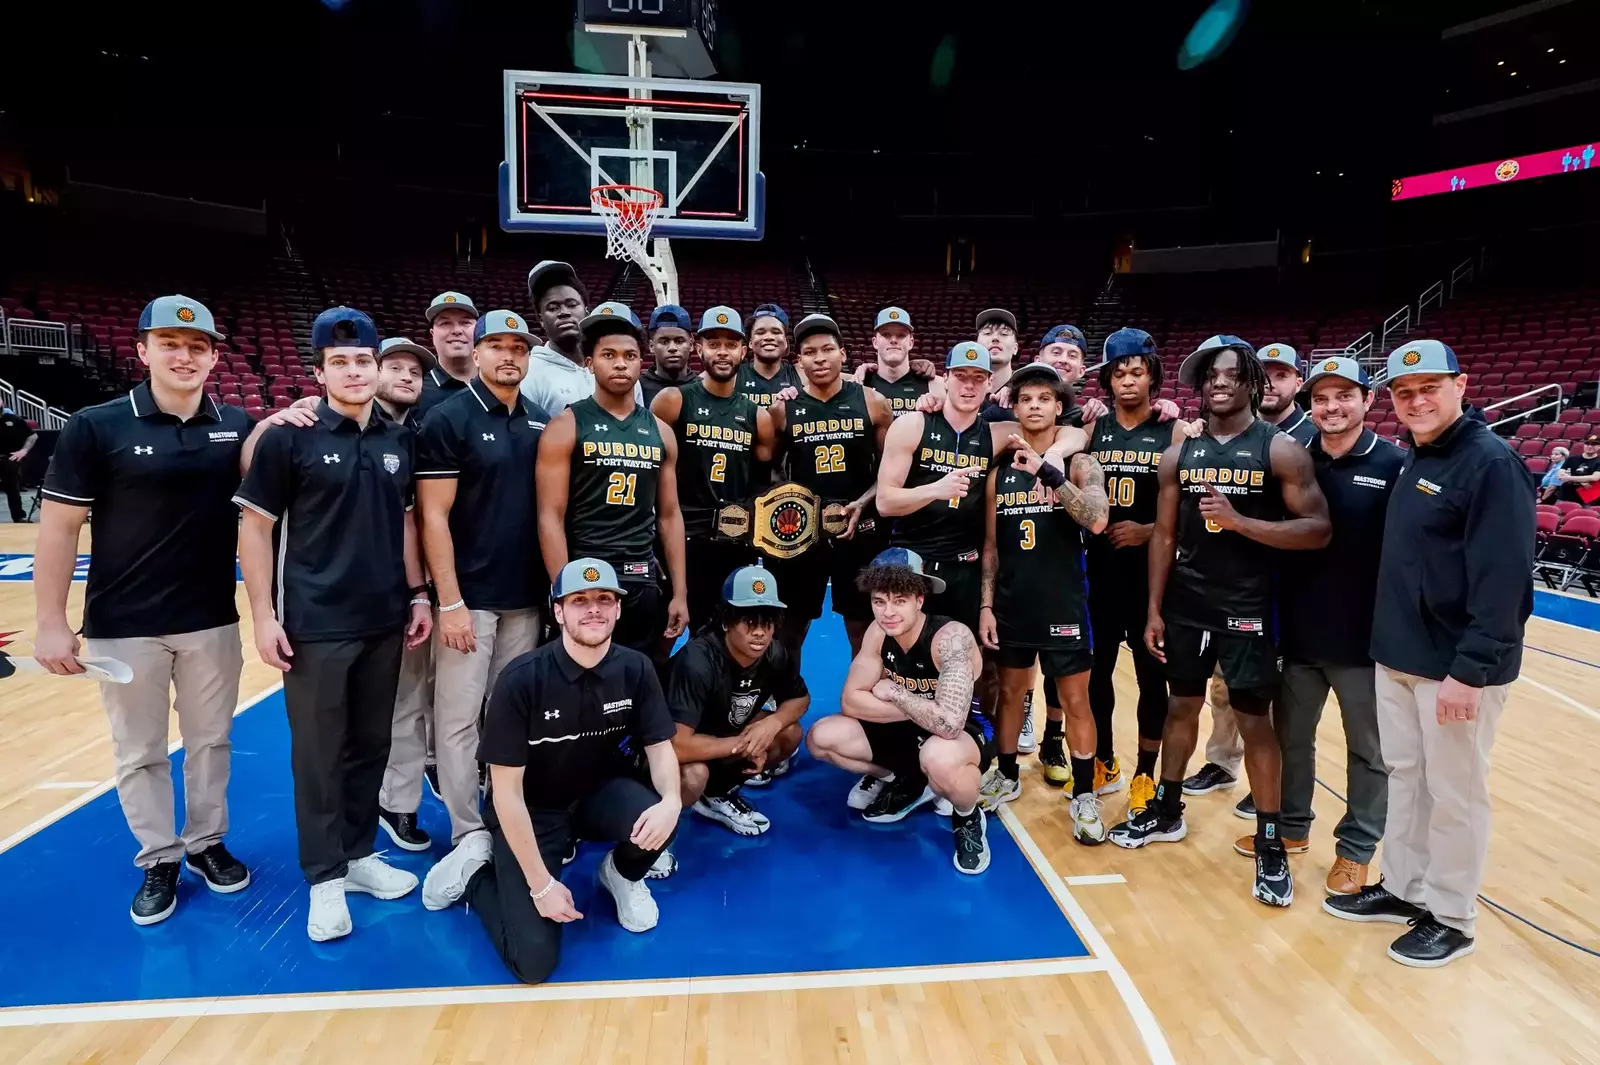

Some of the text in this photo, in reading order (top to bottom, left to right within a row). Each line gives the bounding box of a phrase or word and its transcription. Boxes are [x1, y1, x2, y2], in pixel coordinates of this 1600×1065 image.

[686, 423, 752, 445] PURDUE
[792, 418, 865, 437] PURDUE
[696, 438, 743, 452] FORT WAYNE
[803, 432, 854, 443] FORT WAYNE
[583, 441, 661, 462] PURDUE
[814, 444, 846, 475] 22
[920, 447, 989, 470] PURDUE
[596, 458, 653, 469] FORT WAYNE
[710, 452, 727, 483] 2
[1101, 464, 1149, 473] ORT WAYNE
[1180, 467, 1265, 486] PURDUE
[605, 471, 637, 507] 21
[1108, 476, 1135, 507] 10
[1189, 485, 1210, 493] FOR
[996, 490, 1050, 508] PURD
[1004, 505, 1053, 515] FORT WAYNE
[1019, 519, 1036, 550] 3
